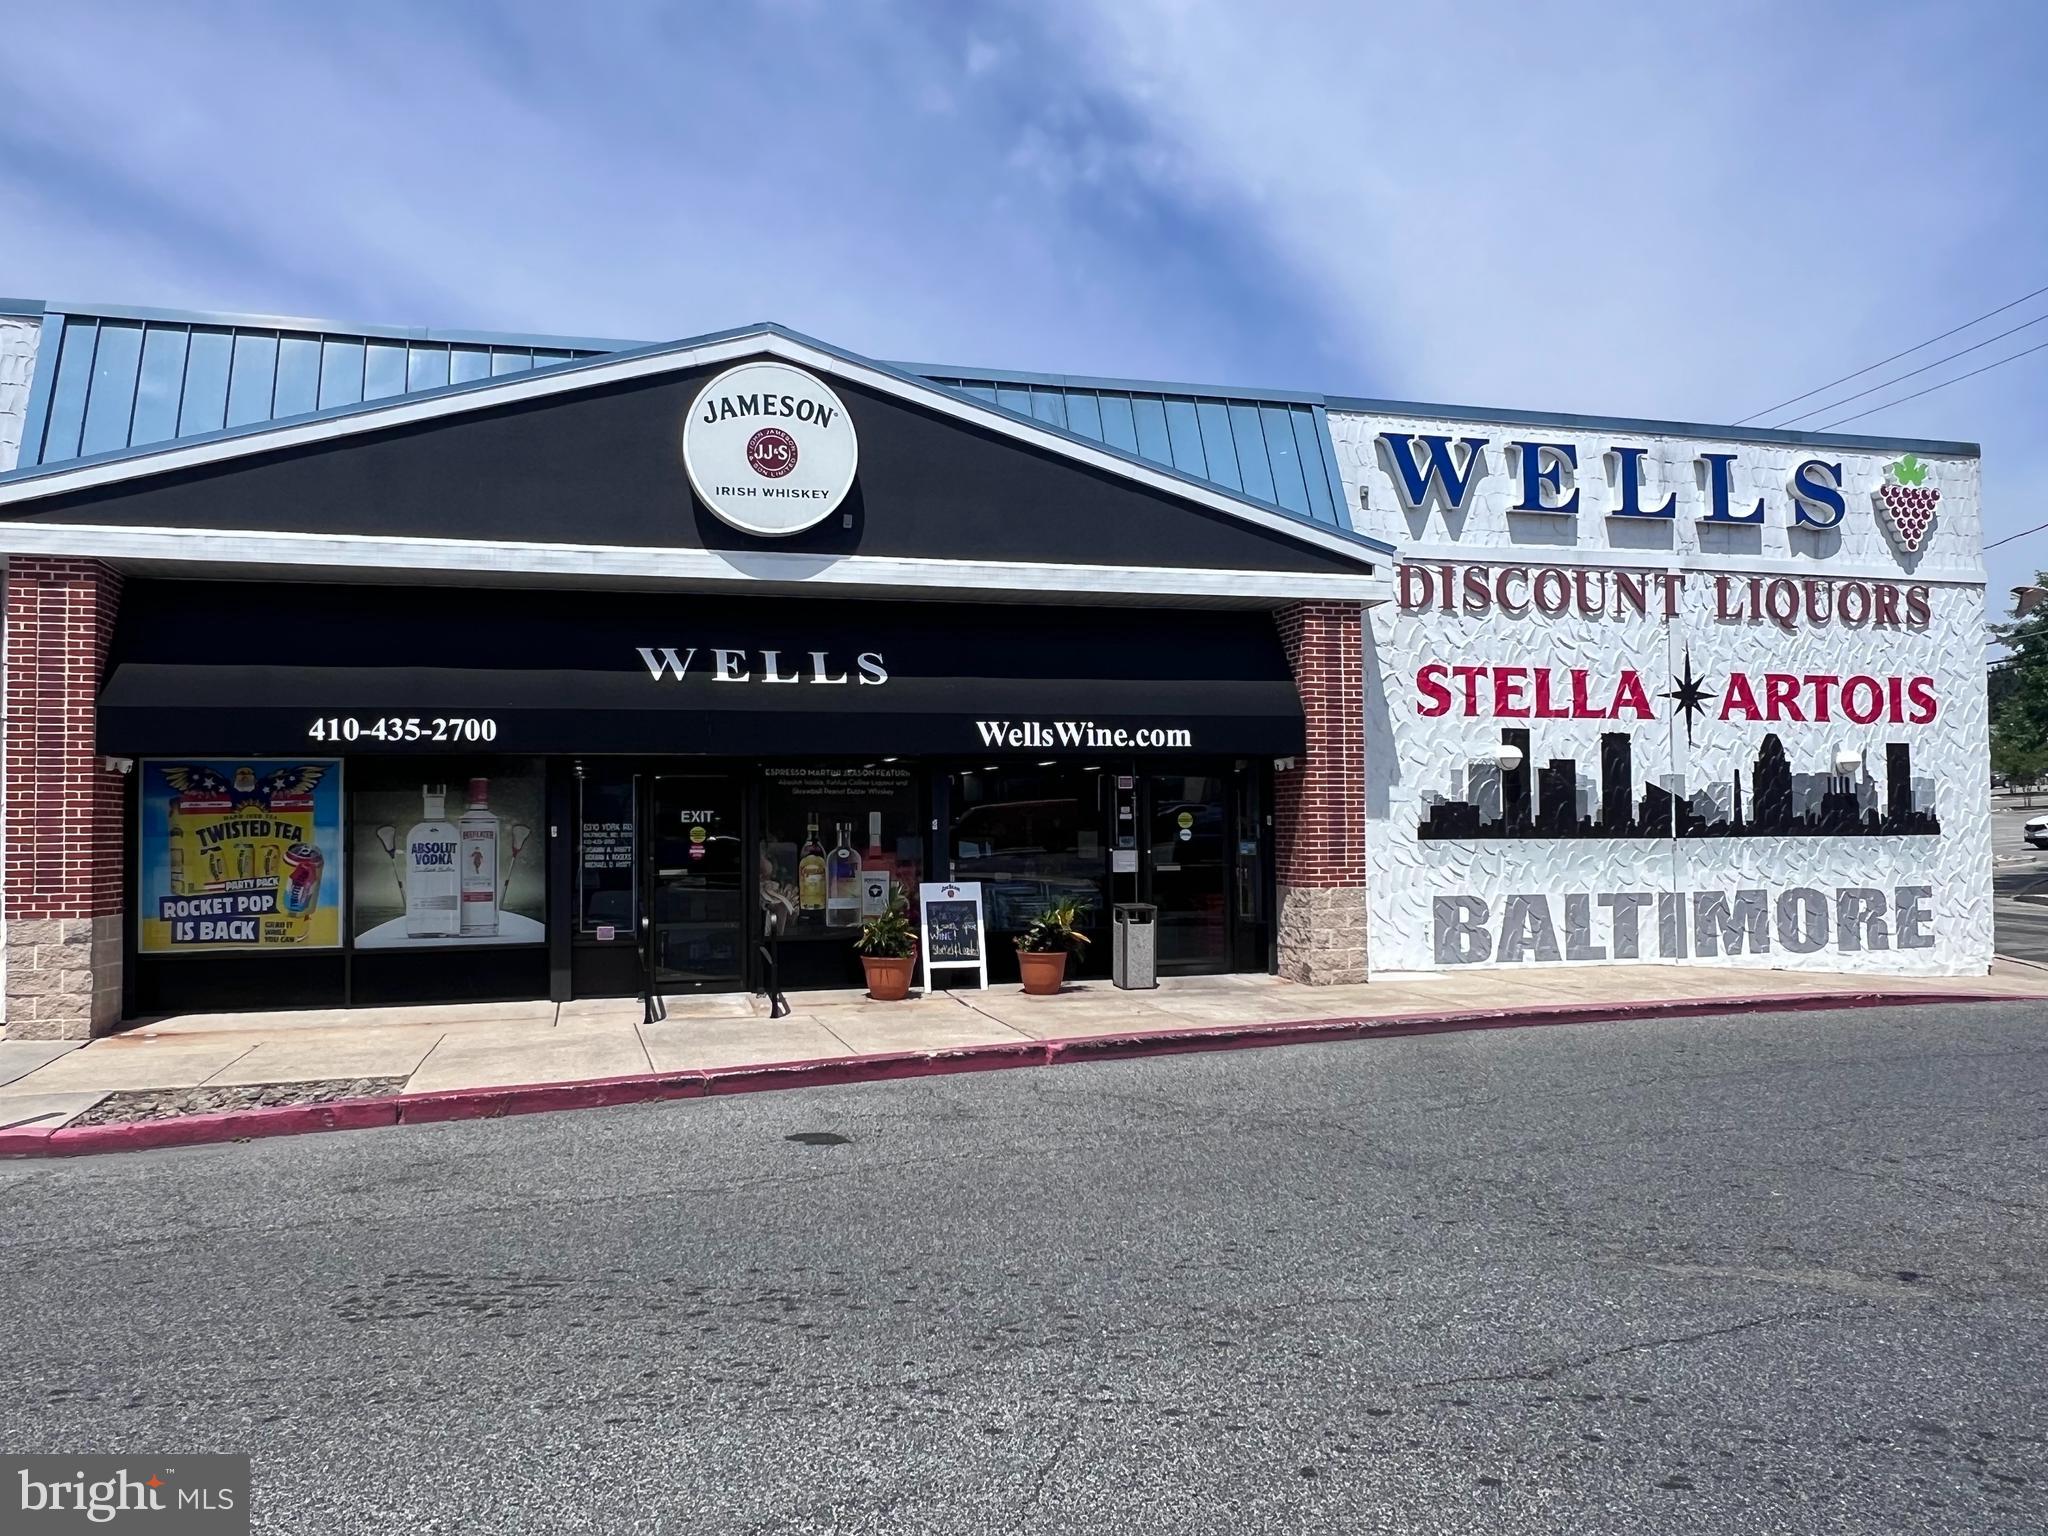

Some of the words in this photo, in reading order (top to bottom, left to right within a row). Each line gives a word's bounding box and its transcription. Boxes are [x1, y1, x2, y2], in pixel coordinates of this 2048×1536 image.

[704, 394, 833, 428] JAMESON
[1379, 432, 1846, 528] WELLS
[716, 487, 757, 497] IRISH
[762, 488, 830, 499] WHISKEY
[1396, 564, 1686, 618] DISCOUNT
[1714, 576, 1931, 628] LIQUORS
[635, 647, 889, 685] WELLS
[1416, 664, 1656, 720] STELLA
[1717, 672, 1938, 725] ARTOIS
[309, 718, 497, 741] 410-435-2700
[976, 721, 1192, 747] WellsWine.com
[680, 810, 715, 823] EXIT
[196, 820, 271, 846] TWISTED
[274, 821, 303, 842] TEA
[411, 842, 457, 854] ABSOLUT
[415, 854, 453, 865] VODKA
[225, 880, 254, 891] PARTY
[256, 877, 279, 888] PACK
[163, 896, 232, 919] ROCKET
[237, 895, 274, 913] POP
[176, 921, 194, 940] IS
[199, 920, 255, 940] BACK
[1433, 885, 1936, 966] BALTIMORE
